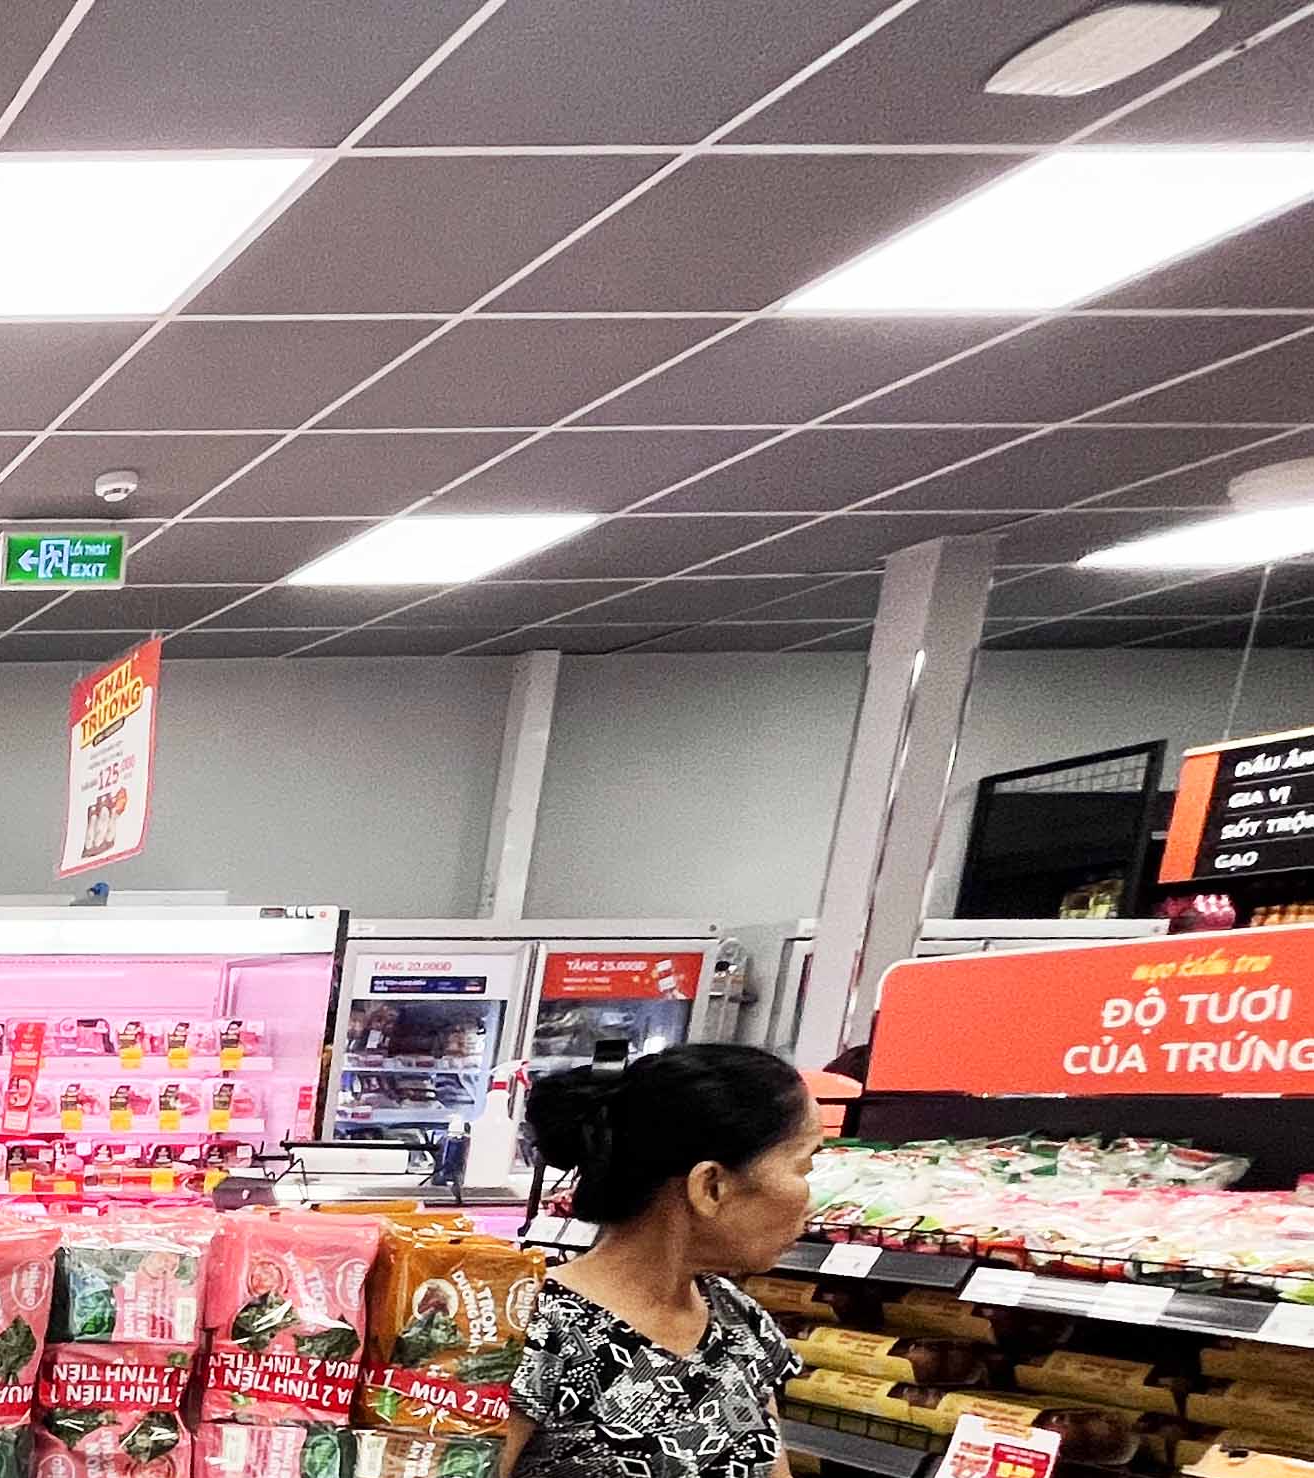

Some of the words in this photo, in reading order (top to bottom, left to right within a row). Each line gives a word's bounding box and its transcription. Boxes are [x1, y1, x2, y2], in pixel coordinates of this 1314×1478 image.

[70, 563, 106, 577] EXIT
[93, 664, 130, 707] KHAI
[1227, 790, 1264, 809] GIA
[1268, 785, 1292, 805] VỊ
[1214, 851, 1259, 872] GẠO
[1101, 986, 1168, 1035] ĐỘ
[1179, 984, 1293, 1026] TƯƠI
[1062, 1035, 1148, 1075] CỦA
[1159, 1030, 1314, 1074] TRỨNG
[106, 1365, 158, 1385] TÍNH
[259, 1354, 304, 1379] TÍNH
[308, 1358, 322, 1380] 2
[120, 1384, 173, 1406] TÍNH
[273, 1376, 320, 1401] TÍNH
[322, 1385, 334, 1407] 2
[409, 1380, 458, 1408] MUA
[462, 1389, 479, 1412] 2
